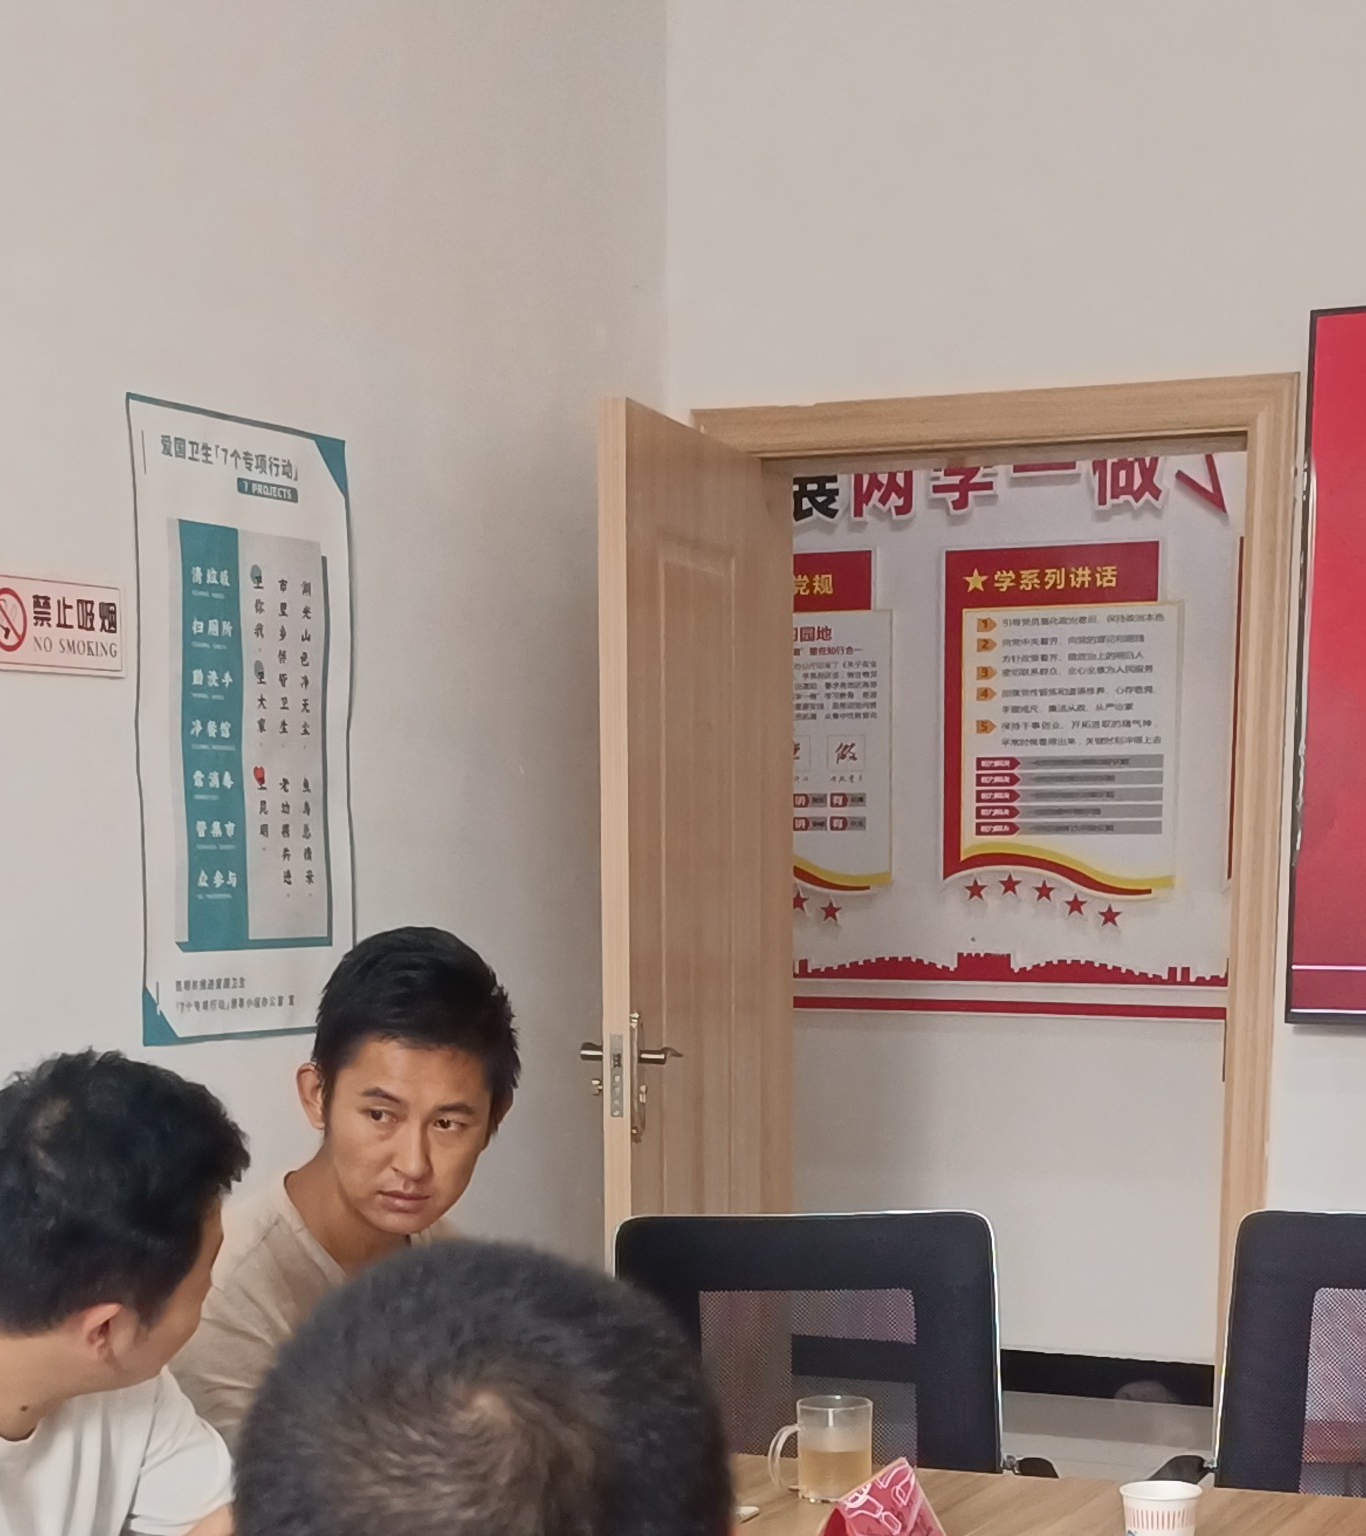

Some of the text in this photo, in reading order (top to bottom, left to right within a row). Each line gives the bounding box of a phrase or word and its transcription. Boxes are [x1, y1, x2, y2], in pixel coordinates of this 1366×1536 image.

[251, 483, 292, 499] PROJECTS
[993, 565, 1119, 593] 学系列讲话
[32, 593, 117, 634] 禁止吸烟
[32, 636, 118, 658] NO SMOKING
